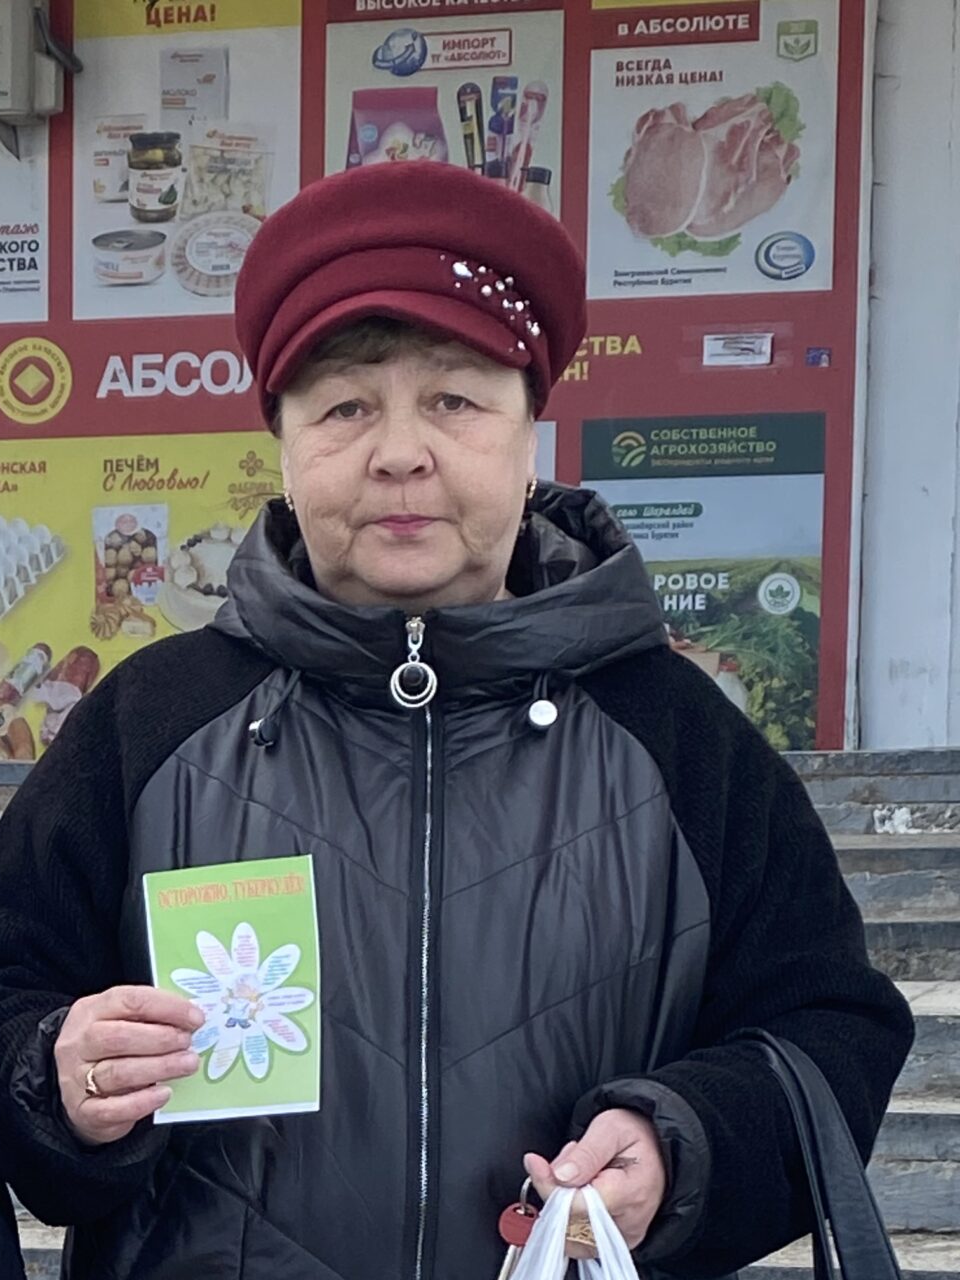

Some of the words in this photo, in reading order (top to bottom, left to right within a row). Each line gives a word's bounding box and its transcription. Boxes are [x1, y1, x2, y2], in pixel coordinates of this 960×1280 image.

[145, 3, 216, 28] ЦЕНА!
[634, 14, 750, 35] АБСОЛЮТЕ
[442, 37, 497, 50] ИМПОРТ
[615, 58, 672, 72] ВСЕГДА
[615, 73, 674, 87] НИЗКАЯ
[678, 70, 724, 85] ЦЕНА!
[650, 426, 758, 441] СОБСТВЕННОЕ
[650, 440, 777, 457] АГРОХОЗЯЙСТВО
[103, 454, 160, 473] ПЕЧЁМ
[653, 572, 730, 591] РОВОЕ
[663, 593, 707, 612] НИЕ
